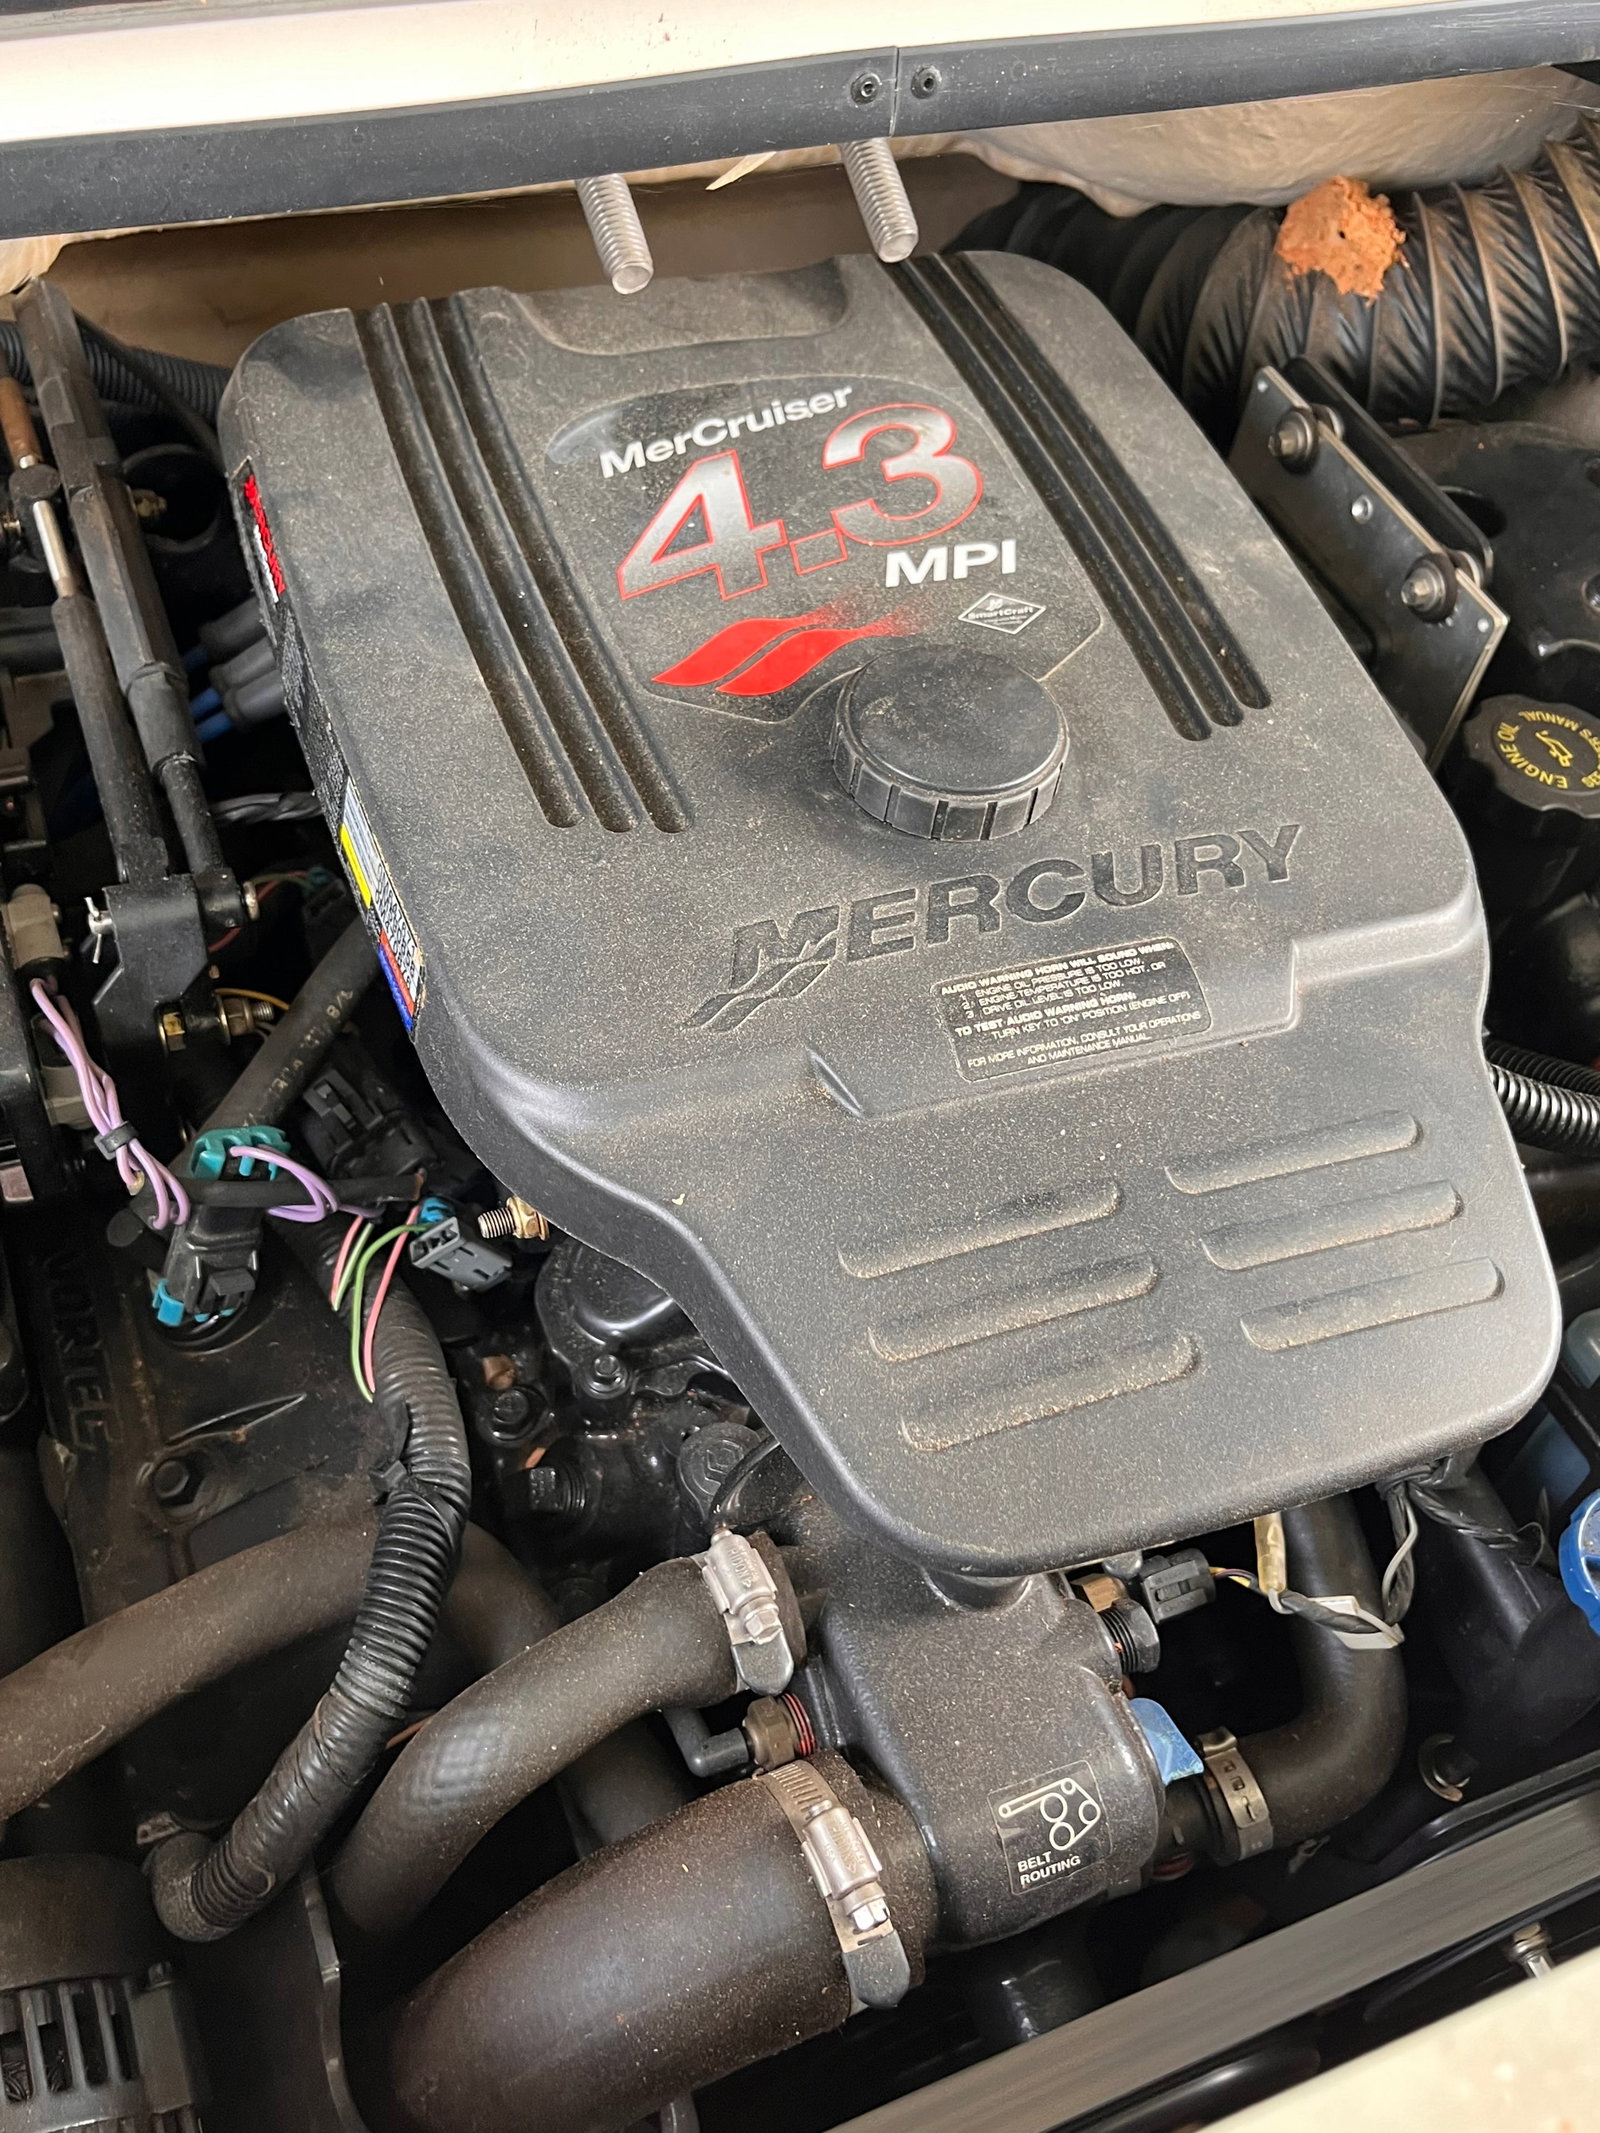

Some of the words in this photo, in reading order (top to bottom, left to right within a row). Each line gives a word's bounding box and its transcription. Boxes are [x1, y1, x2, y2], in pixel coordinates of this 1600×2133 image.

[599, 386, 853, 479] MerCruiser
[616, 402, 984, 601] 4.3
[885, 539, 1017, 589] MPI
[967, 606, 1034, 621] SmartCraft
[1497, 721, 1520, 742] OIL
[1518, 711, 1579, 732] MANUAL
[1500, 743, 1569, 789] ENGINE
[731, 824, 1302, 990] MERCURY
[941, 980, 977, 996] AUDIO
[979, 968, 1034, 988] WARNING
[1034, 961, 1069, 976] HORN
[1069, 957, 1097, 969] WILL
[1096, 948, 1138, 964] SOUND
[975, 983, 1013, 998] ENGINE
[1013, 980, 1032, 990] OIL
[1031, 968, 1084, 987] PRESSURE
[1084, 966, 1096, 975] IS
[1096, 962, 1118, 972] TOO
[1120, 957, 1145, 968] LOW.
[978, 991, 1019, 1007] ENGINE
[1018, 976, 1091, 998] TEMPERATURE
[1090, 974, 1102, 983] IS
[1102, 969, 1125, 980] TOO
[1150, 961, 1167, 971] OR
[954, 1025, 973, 1038] TO
[973, 1018, 1004, 1033] TEST
[1006, 1010, 1044, 1026] AUDIO
[1044, 997, 1099, 1017] WARNING
[982, 1002, 1014, 1016] DRIVE
[1013, 999, 1032, 1009] OIL
[1031, 992, 1064, 1005] LEVEL
[1063, 989, 1074, 998] IS
[1075, 984, 1098, 996] TOO
[1098, 979, 1125, 992] LOW.
[990, 1026, 1021, 1040] TURN
[1021, 1021, 1041, 1033] KEY
[1042, 1017, 1060, 1029] TO
[1081, 1003, 1128, 1021] POSITION
[1128, 995, 1168, 1011] (ENGINE
[1167, 990, 1191, 1003] OFF)
[966, 1055, 987, 1069] FOR
[987, 1049, 1016, 1064] MORE
[1079, 1026, 1121, 1044] CONSULT
[1122, 1021, 1148, 1034] YOUR
[1148, 1010, 1201, 1029] OPERATIONS
[1027, 1053, 1048, 1065] AND
[1047, 1038, 1112, 1061] MAINTENANCE
[1017, 1850, 1052, 1873] BELT
[1019, 1855, 1081, 1887] ROUTING
